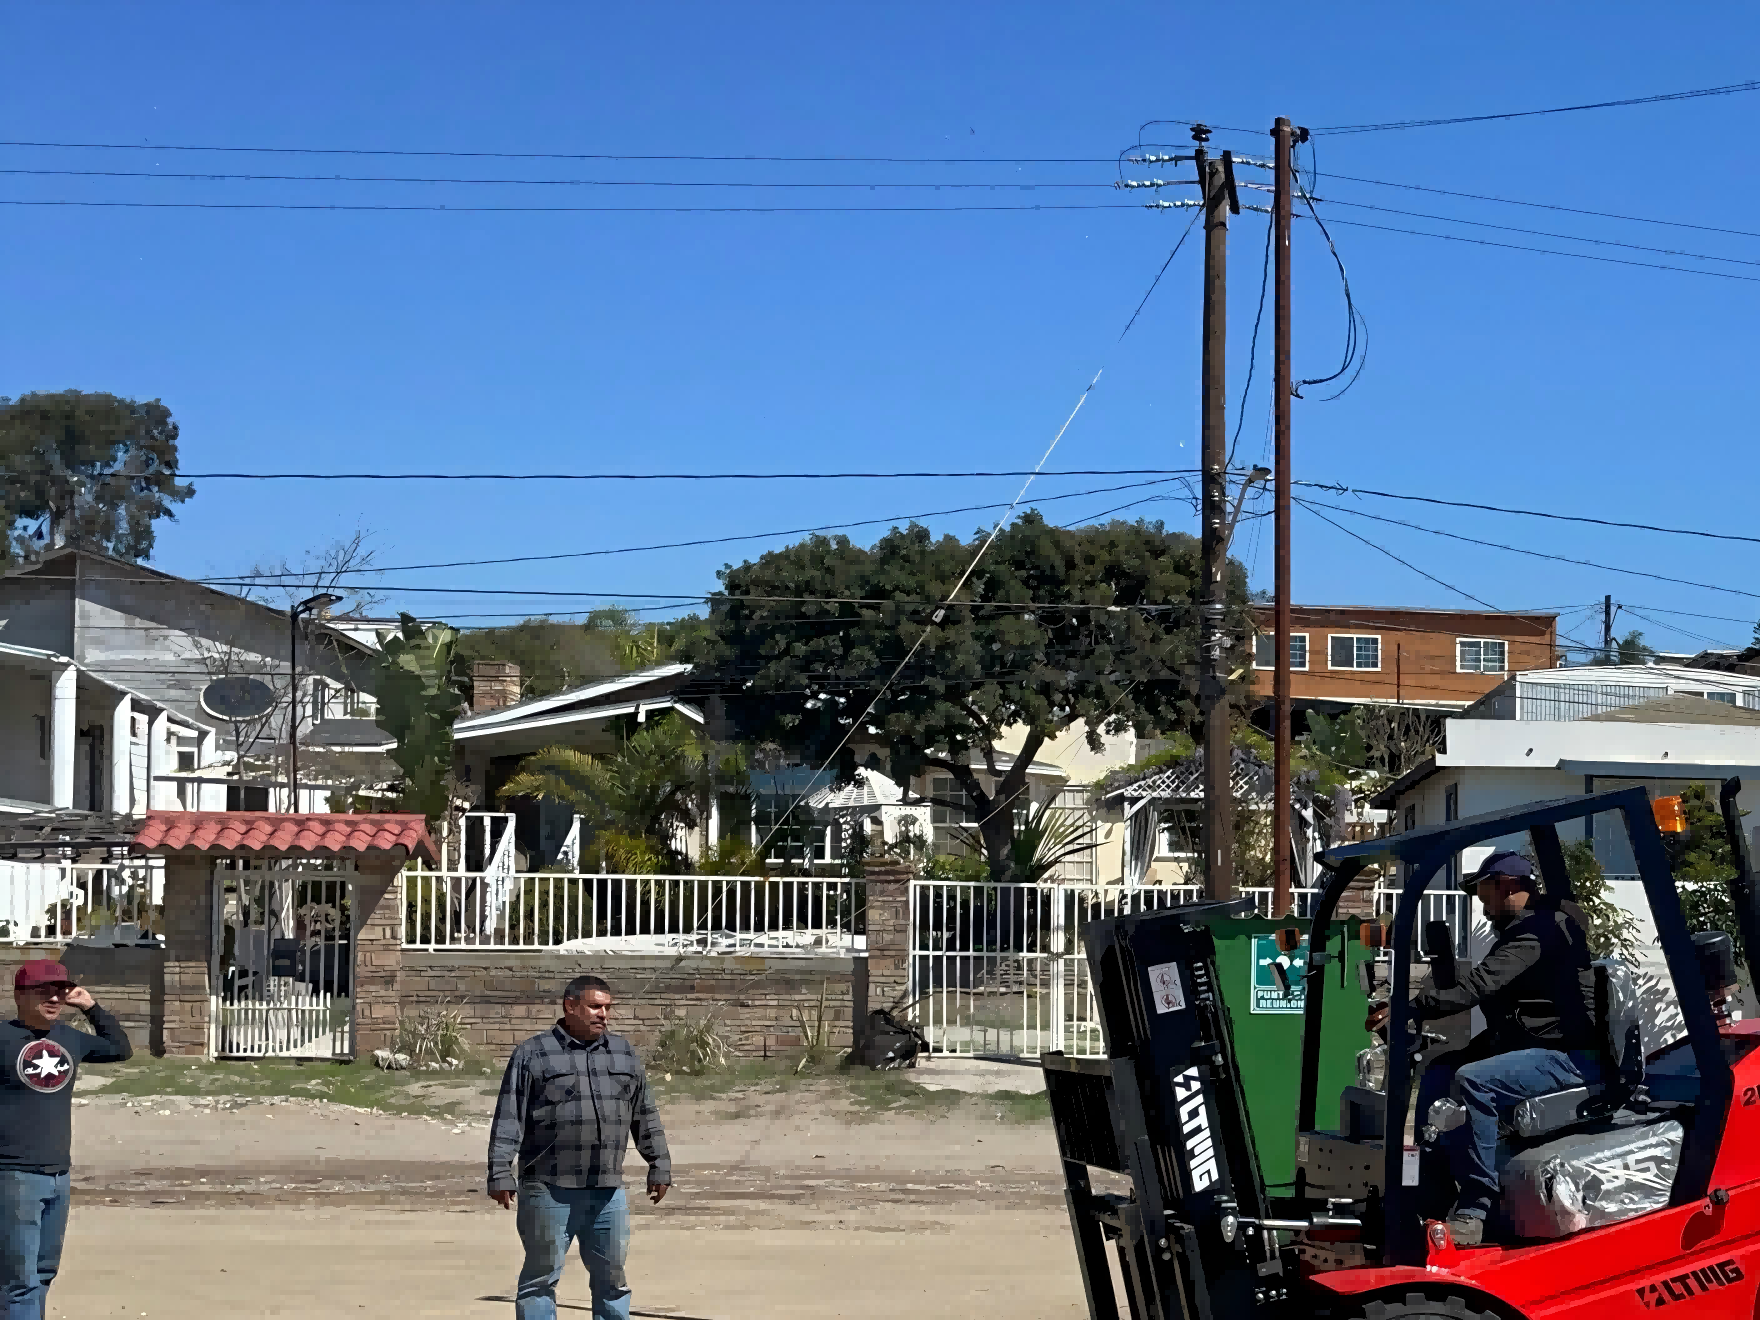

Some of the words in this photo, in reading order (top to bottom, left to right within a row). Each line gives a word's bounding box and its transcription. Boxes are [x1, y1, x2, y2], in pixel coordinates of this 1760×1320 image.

[1257, 990, 1290, 999] PUNT
[1179, 1093, 1219, 1193] LTMG
[1655, 1258, 1745, 1302] LTMG
